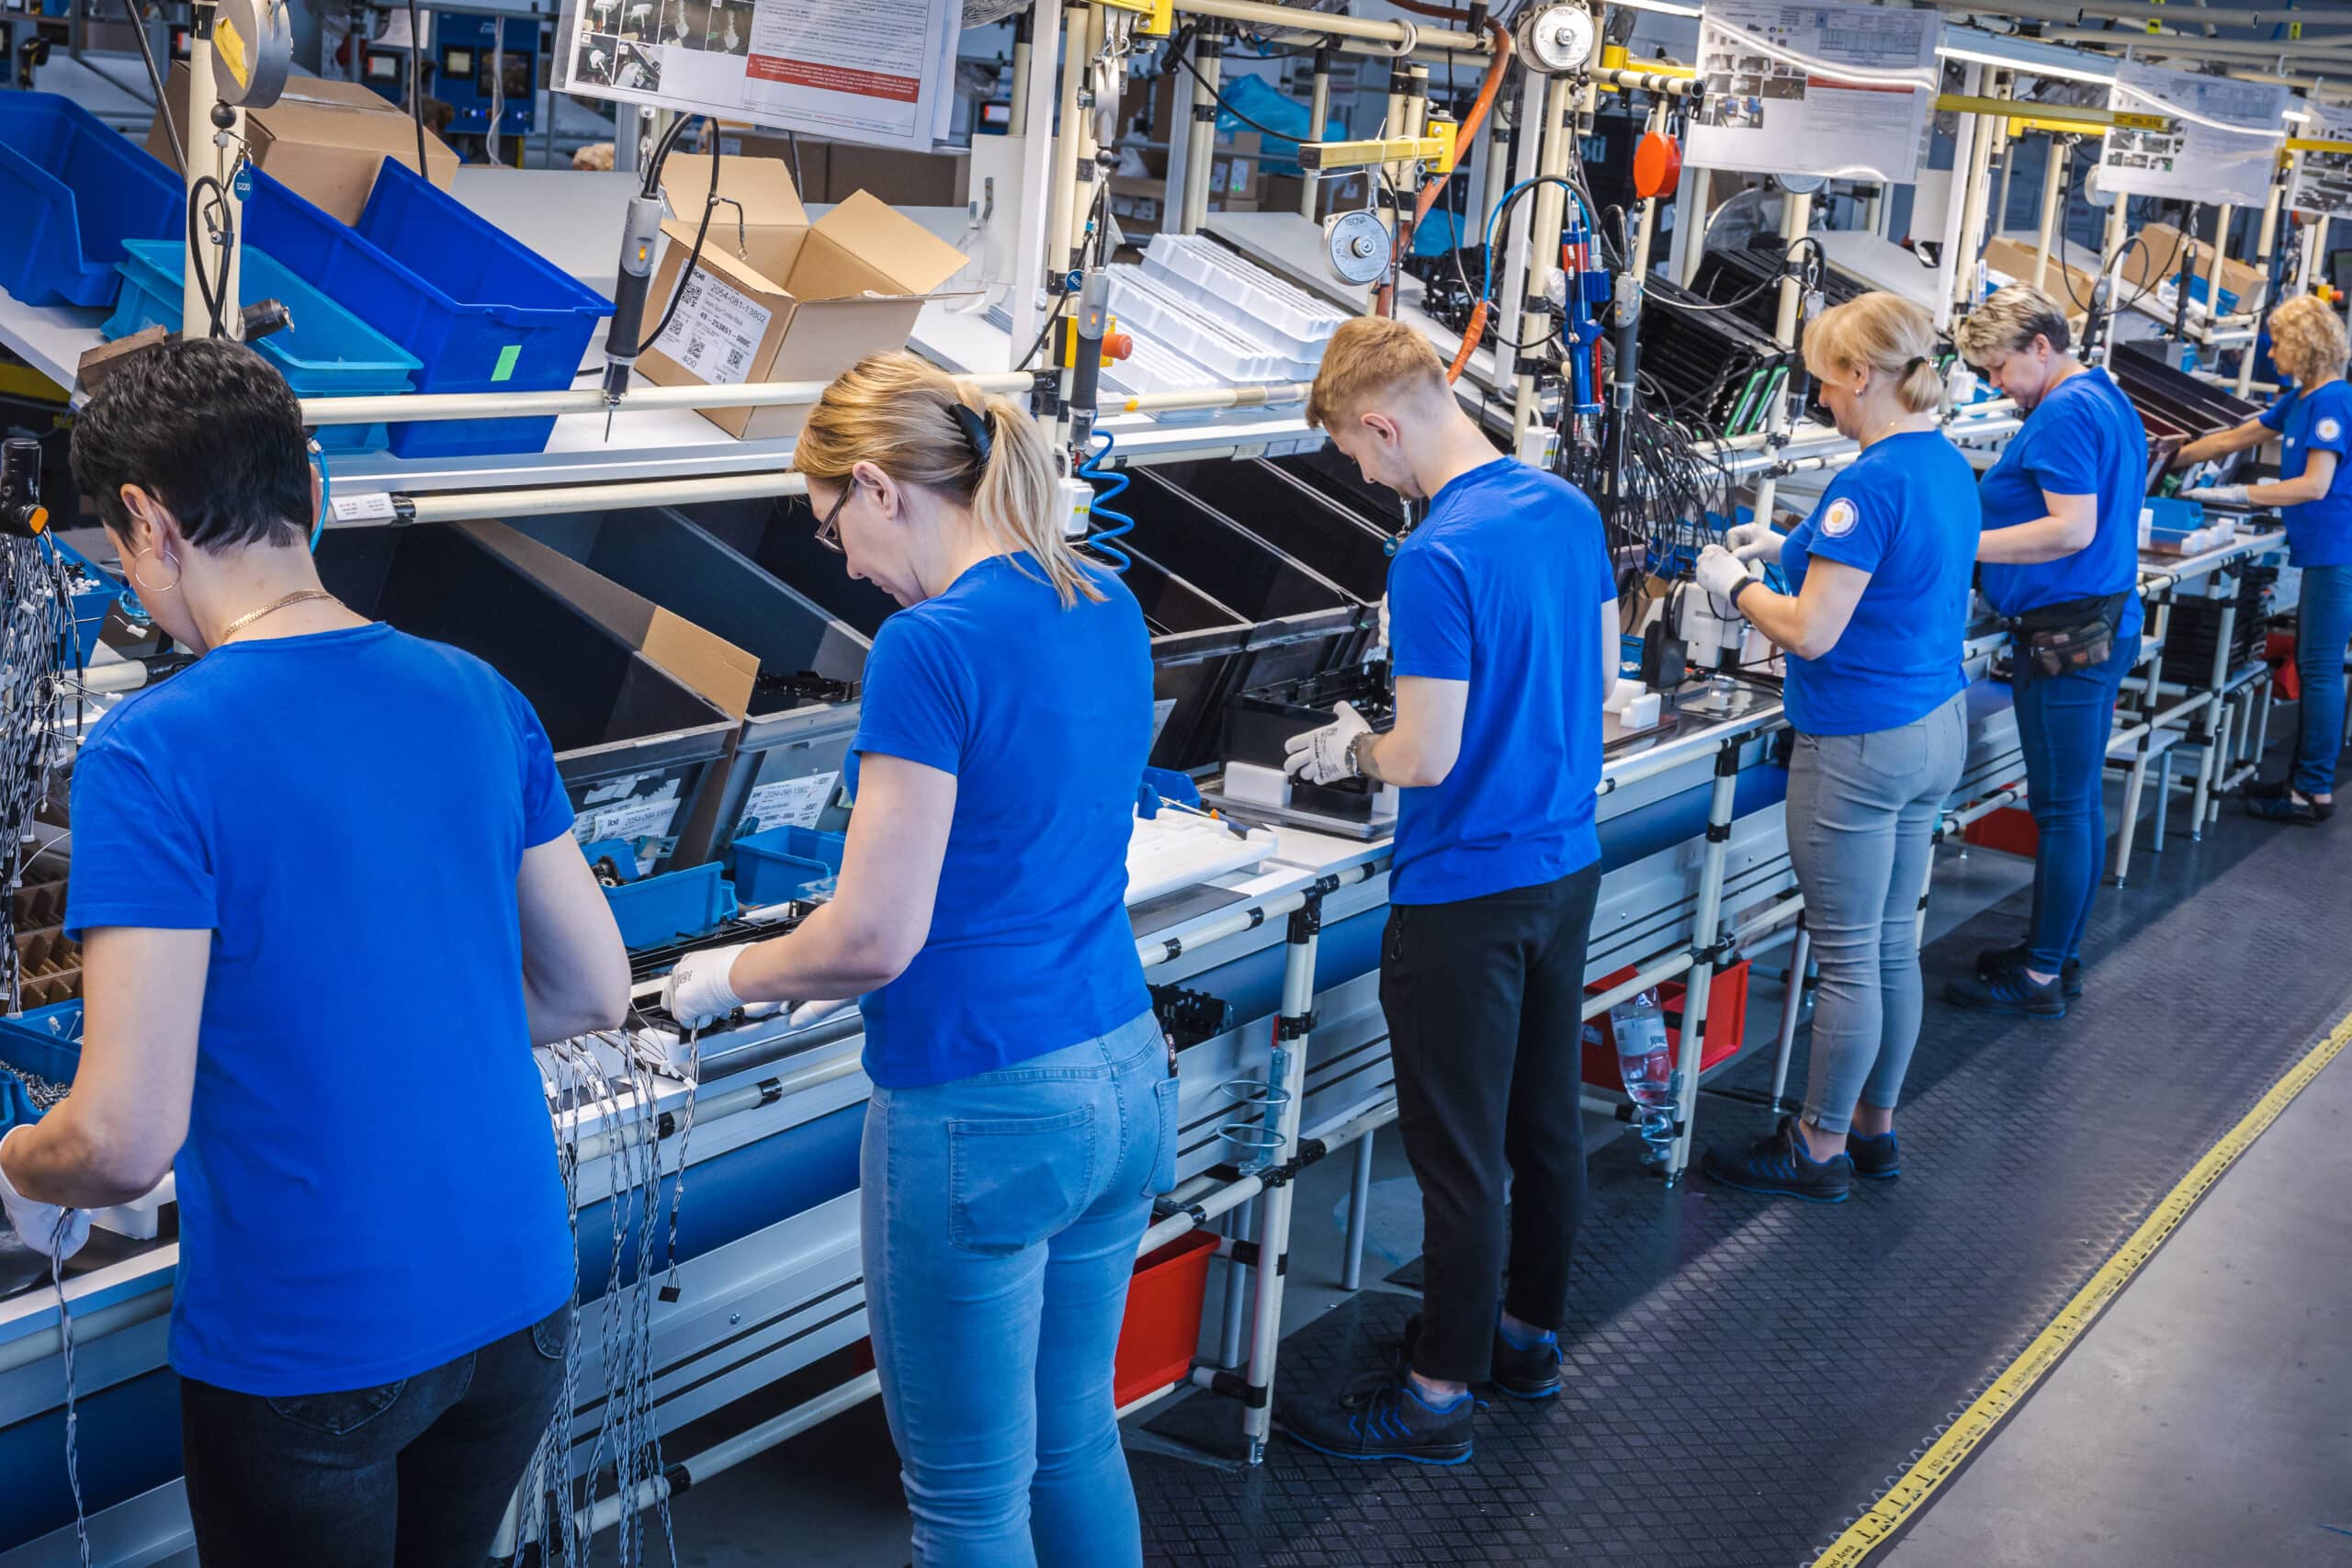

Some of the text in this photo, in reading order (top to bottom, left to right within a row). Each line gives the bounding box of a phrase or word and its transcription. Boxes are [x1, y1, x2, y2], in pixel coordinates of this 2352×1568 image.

[710, 283, 766, 324] 2054-081-13802
[682, 355, 697, 368] 400
[1837, 1545, 1855, 1559] Area
